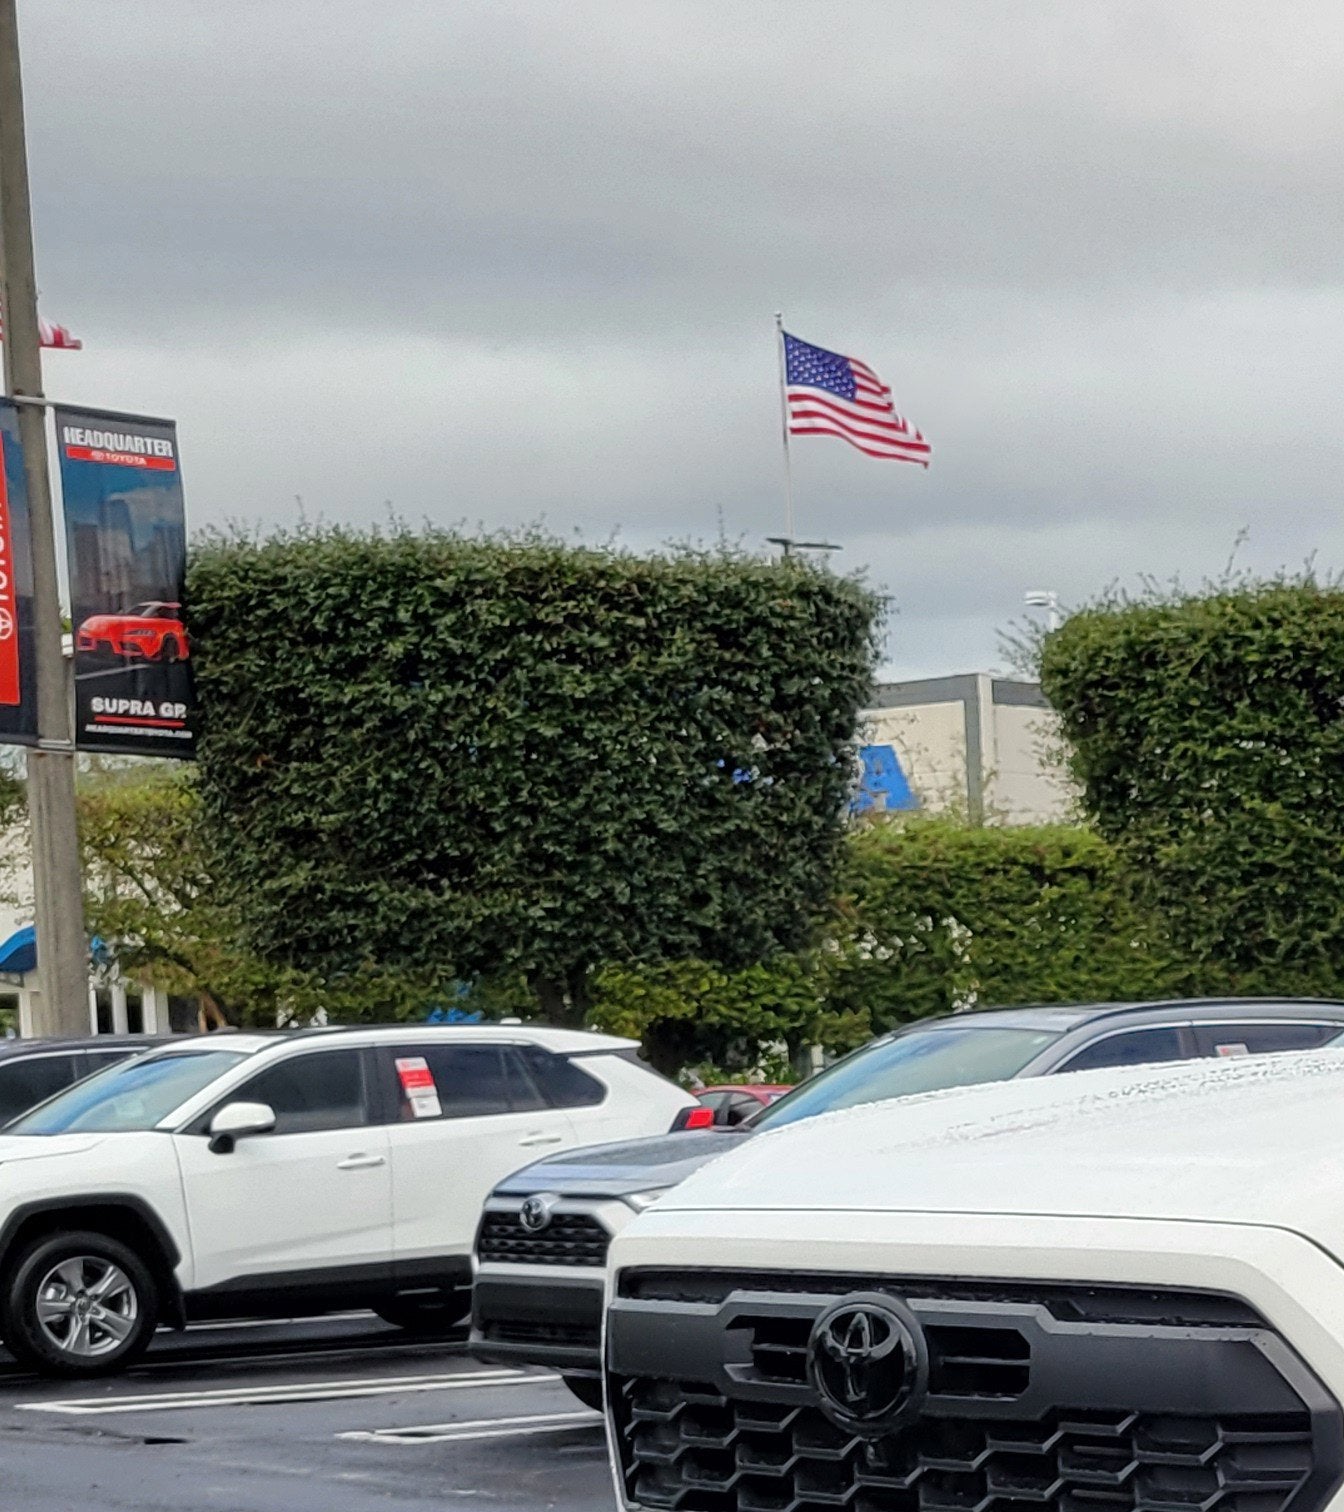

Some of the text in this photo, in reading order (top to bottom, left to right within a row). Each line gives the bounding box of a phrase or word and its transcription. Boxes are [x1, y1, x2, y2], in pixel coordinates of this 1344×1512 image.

[63, 426, 174, 458] HEADQUARTER
[106, 452, 148, 466] TOYOTA
[91, 696, 156, 716] SUPRA
